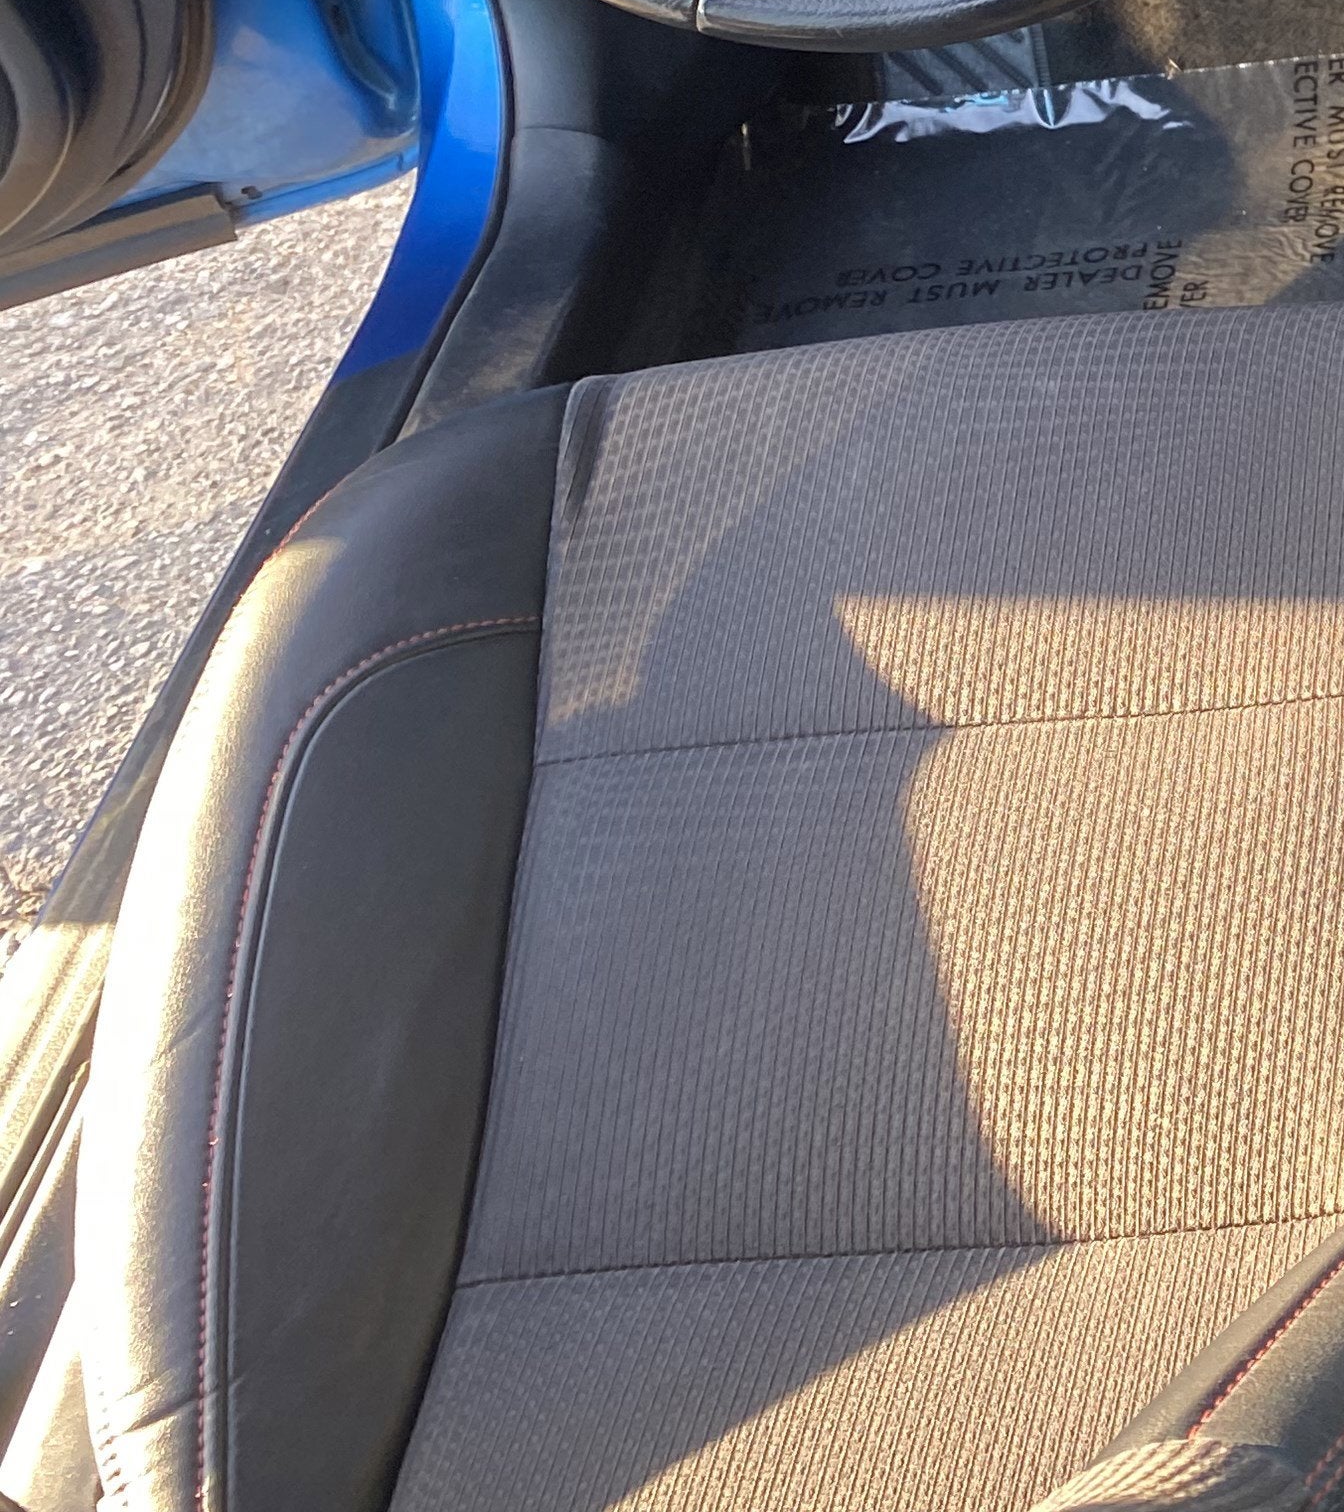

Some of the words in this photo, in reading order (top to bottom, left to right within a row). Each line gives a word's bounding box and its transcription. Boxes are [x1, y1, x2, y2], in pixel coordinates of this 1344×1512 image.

[1293, 61, 1319, 148] ECTIVE
[1283, 159, 1315, 224] COVER
[836, 263, 941, 288] COVER
[958, 241, 1148, 277] PROTECTIVE
[906, 279, 1002, 306] MUST
[1024, 263, 1144, 293] DEALER
